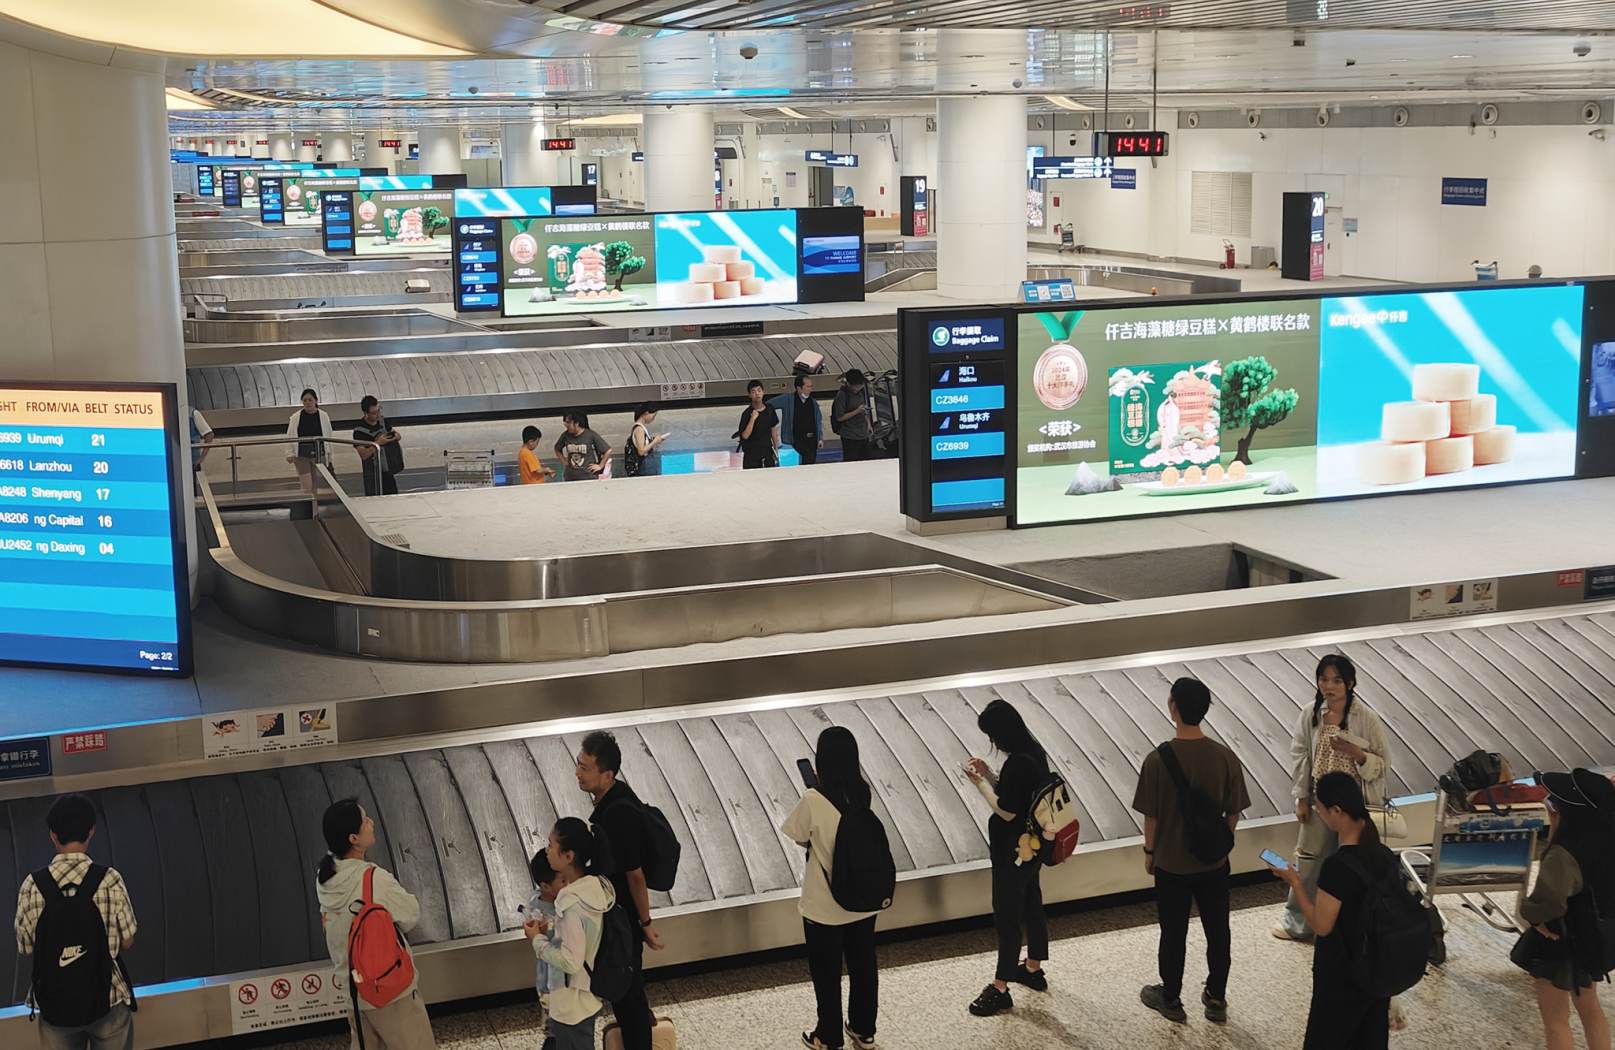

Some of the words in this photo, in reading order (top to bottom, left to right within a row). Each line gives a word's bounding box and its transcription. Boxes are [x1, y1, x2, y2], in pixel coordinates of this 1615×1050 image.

[915, 179, 926, 193] 19
[1312, 196, 1324, 217] 20
[1330, 313, 1376, 328] Kengee
[952, 326, 982, 336] 行李提取
[952, 337, 980, 346] Baggage
[981, 335, 999, 343] Claim
[959, 366, 975, 376] 海口
[935, 395, 969, 405] CZ3846
[26, 401, 80, 414] FROM/VIA
[85, 403, 108, 414] BELT
[114, 403, 153, 415] STATUS
[959, 412, 990, 423] 乌鲁木齐
[27, 433, 64, 447] Urumqi
[91, 433, 105, 446] 21
[936, 441, 969, 452] CZ6939
[0, 459, 24, 471] 6618
[29, 460, 73, 473] Lanzhou
[93, 461, 109, 474] 20
[31, 486, 82, 502] Shenyang
[96, 488, 110, 501] 17
[34, 515, 47, 528] ng
[48, 514, 84, 528] Capital
[98, 515, 113, 528] 16
[36, 542, 49, 554] ng
[50, 541, 86, 555] Daxing
[99, 542, 115, 555] 04
[139, 650, 161, 661] Page:
[161, 651, 173, 661] 2/2
[65, 733, 104, 751] 严禁踩踏
[62, 945, 83, 958] NIKE
